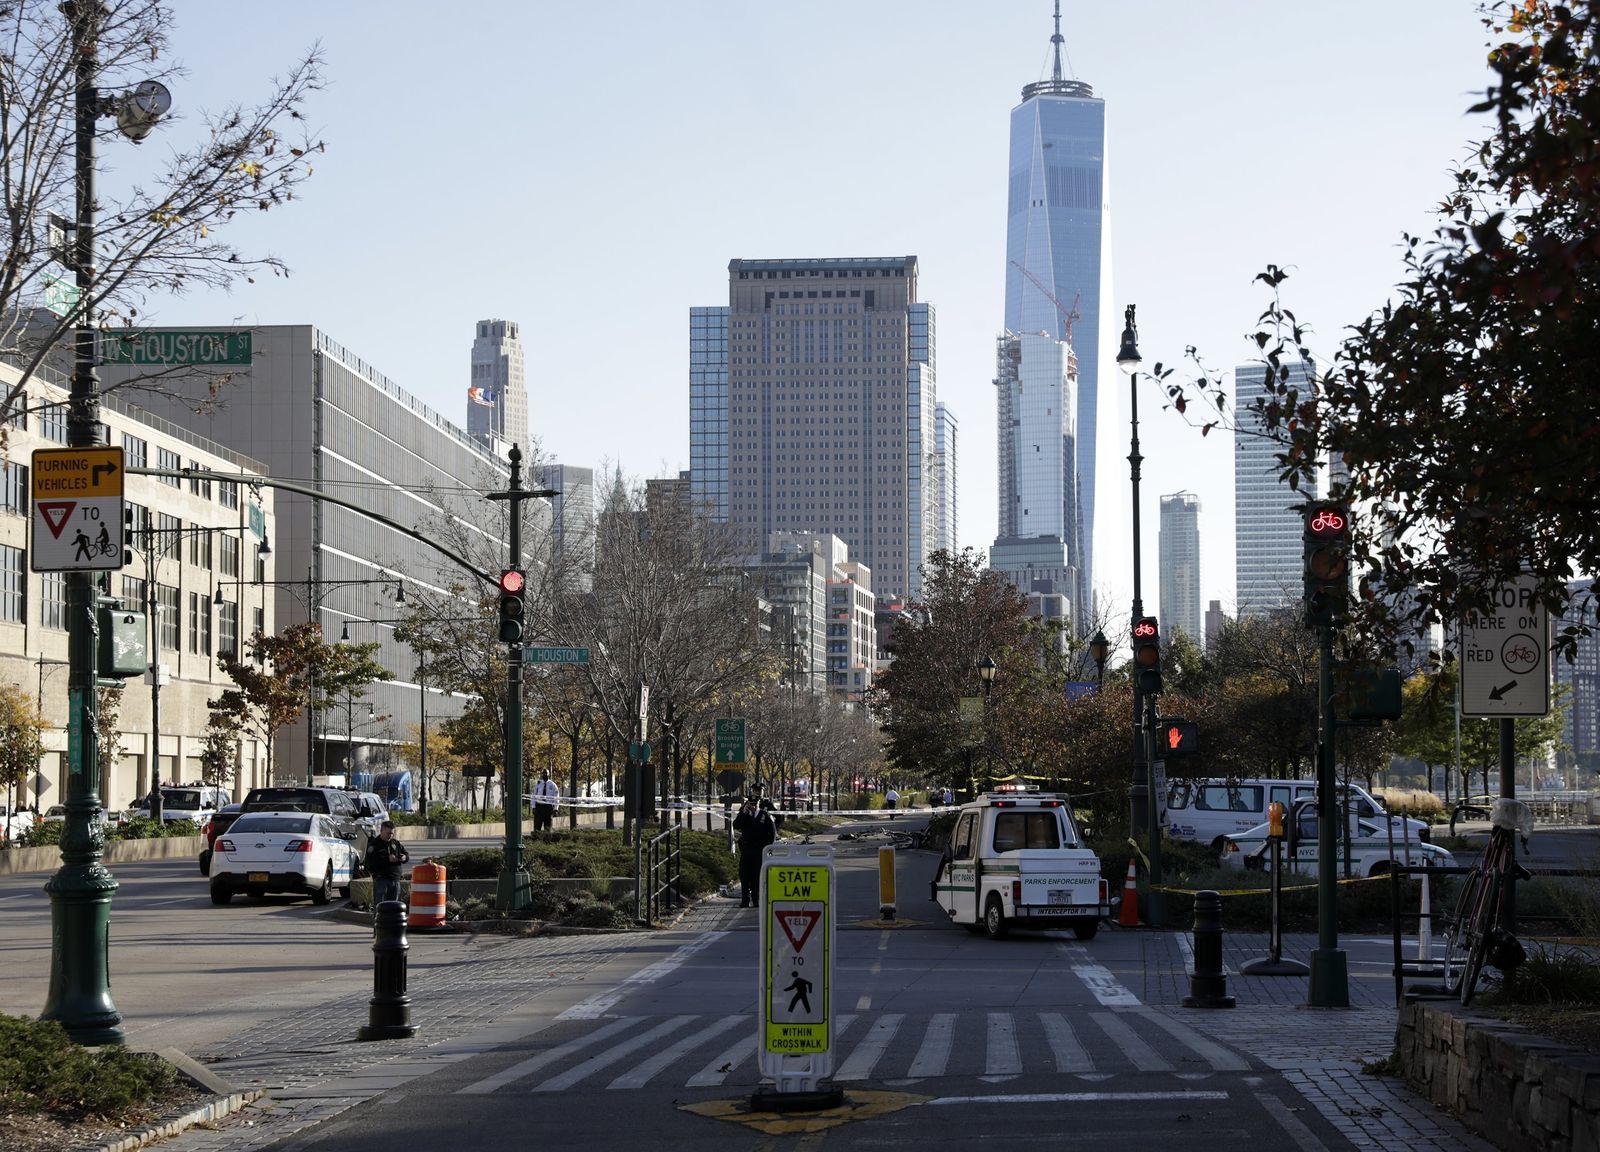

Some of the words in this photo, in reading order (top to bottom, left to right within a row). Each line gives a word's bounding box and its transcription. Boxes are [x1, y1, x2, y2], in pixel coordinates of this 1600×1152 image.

[105, 334, 121, 360] W
[132, 333, 229, 361] HOUSTON
[238, 336, 249, 349] ST
[37, 459, 89, 471] TURNING
[37, 478, 88, 490] VEHICLES
[82, 506, 100, 520] TO
[1469, 617, 1506, 630] HERE
[1518, 616, 1538, 629] ON
[526, 649, 534, 661] W
[537, 649, 579, 661] HOUSTON
[1467, 649, 1494, 662] RED
[1299, 848, 1315, 856] NYC
[778, 871, 817, 883] STATE
[961, 873, 975, 882] PARKS
[784, 886, 811, 897] LAW
[1037, 907, 1078, 915] INTERCEPTOR
[788, 917, 809, 927] YELD
[791, 956, 805, 966] TO
[782, 1027, 813, 1037] WITHIN
[772, 1039, 821, 1048] CROSSWALK
